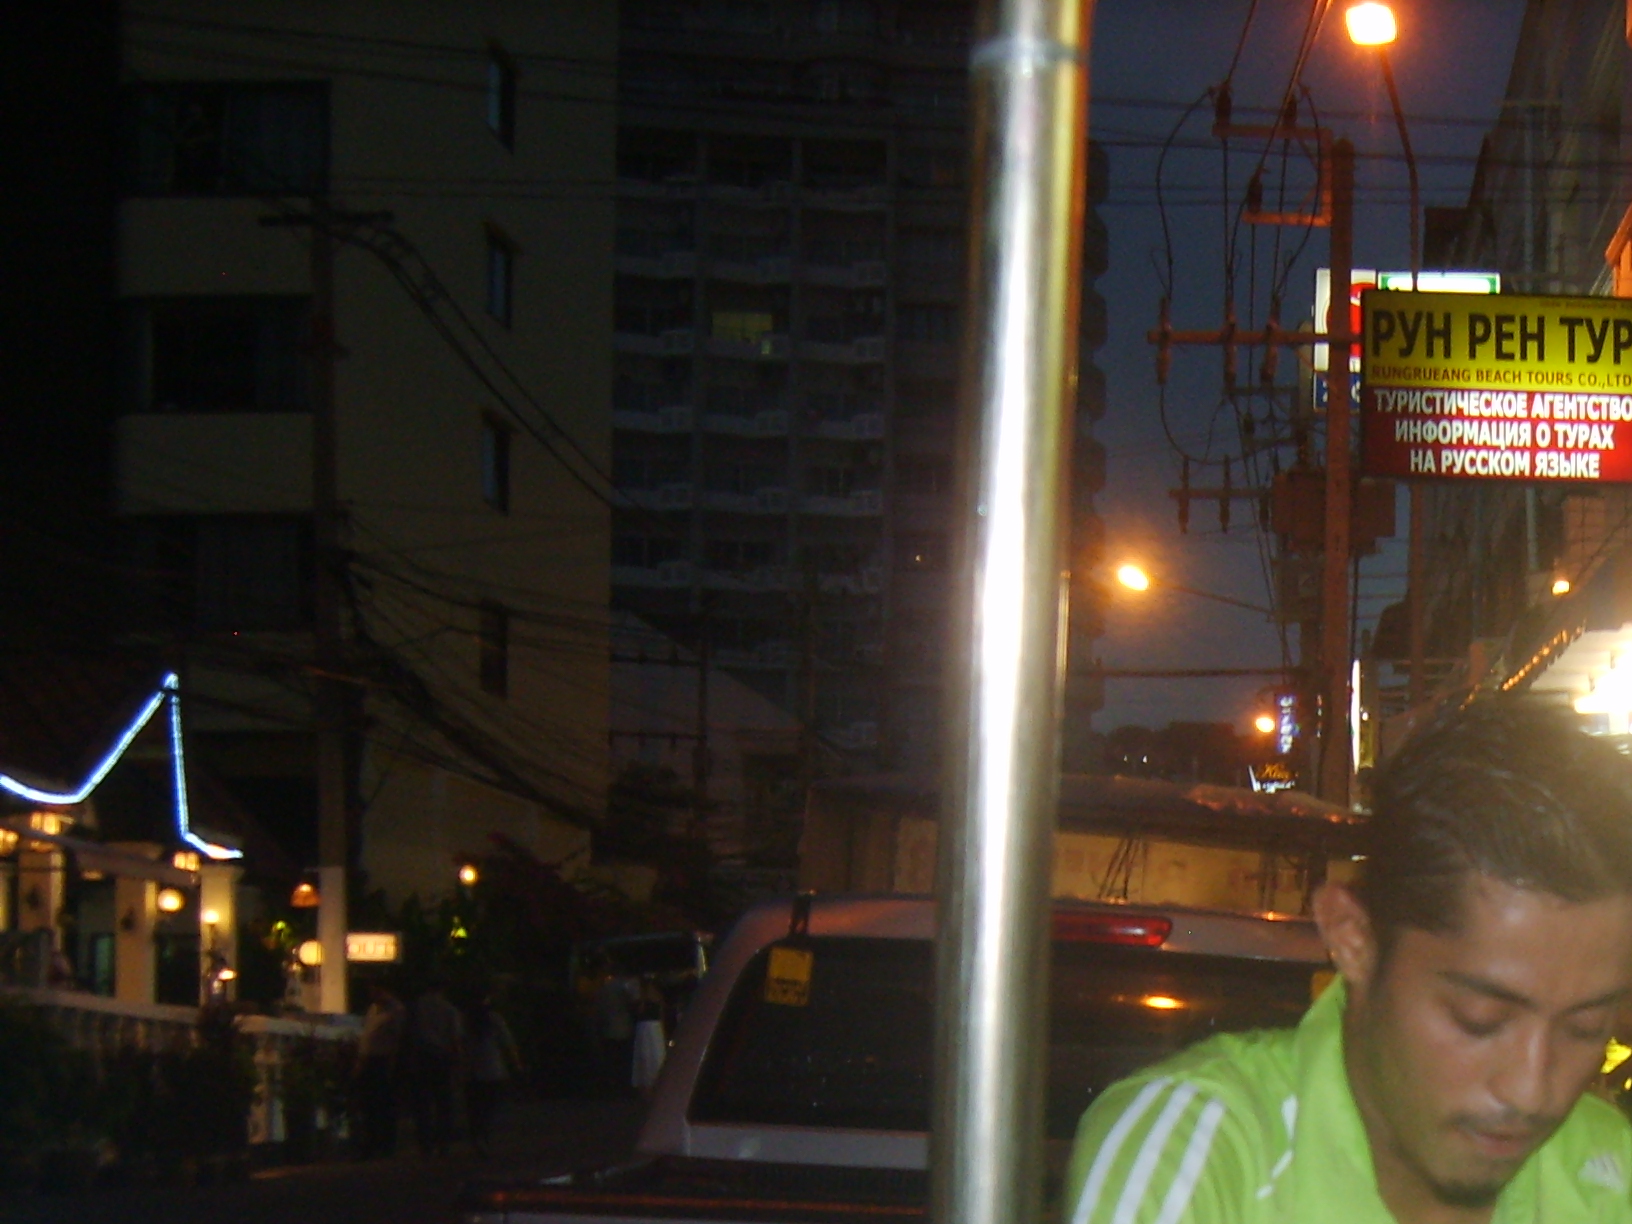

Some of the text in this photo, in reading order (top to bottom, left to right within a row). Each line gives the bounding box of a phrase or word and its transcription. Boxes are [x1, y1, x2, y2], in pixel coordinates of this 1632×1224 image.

[1371, 309, 1452, 360] РУН
[1468, 313, 1546, 363] РЕН
[1371, 365, 1472, 383] RUNGRUEANG
[1475, 369, 1523, 385] BEACH
[1526, 371, 1574, 387] TOURS
[1374, 388, 1528, 419] ТУРИСТИЧЕСКОЕ
[1395, 419, 1616, 451] ИНФОРМАЦИЯ О ТУРАХ
[1409, 448, 1601, 479] НА РУССКОМ ЯЗЫКЕ
